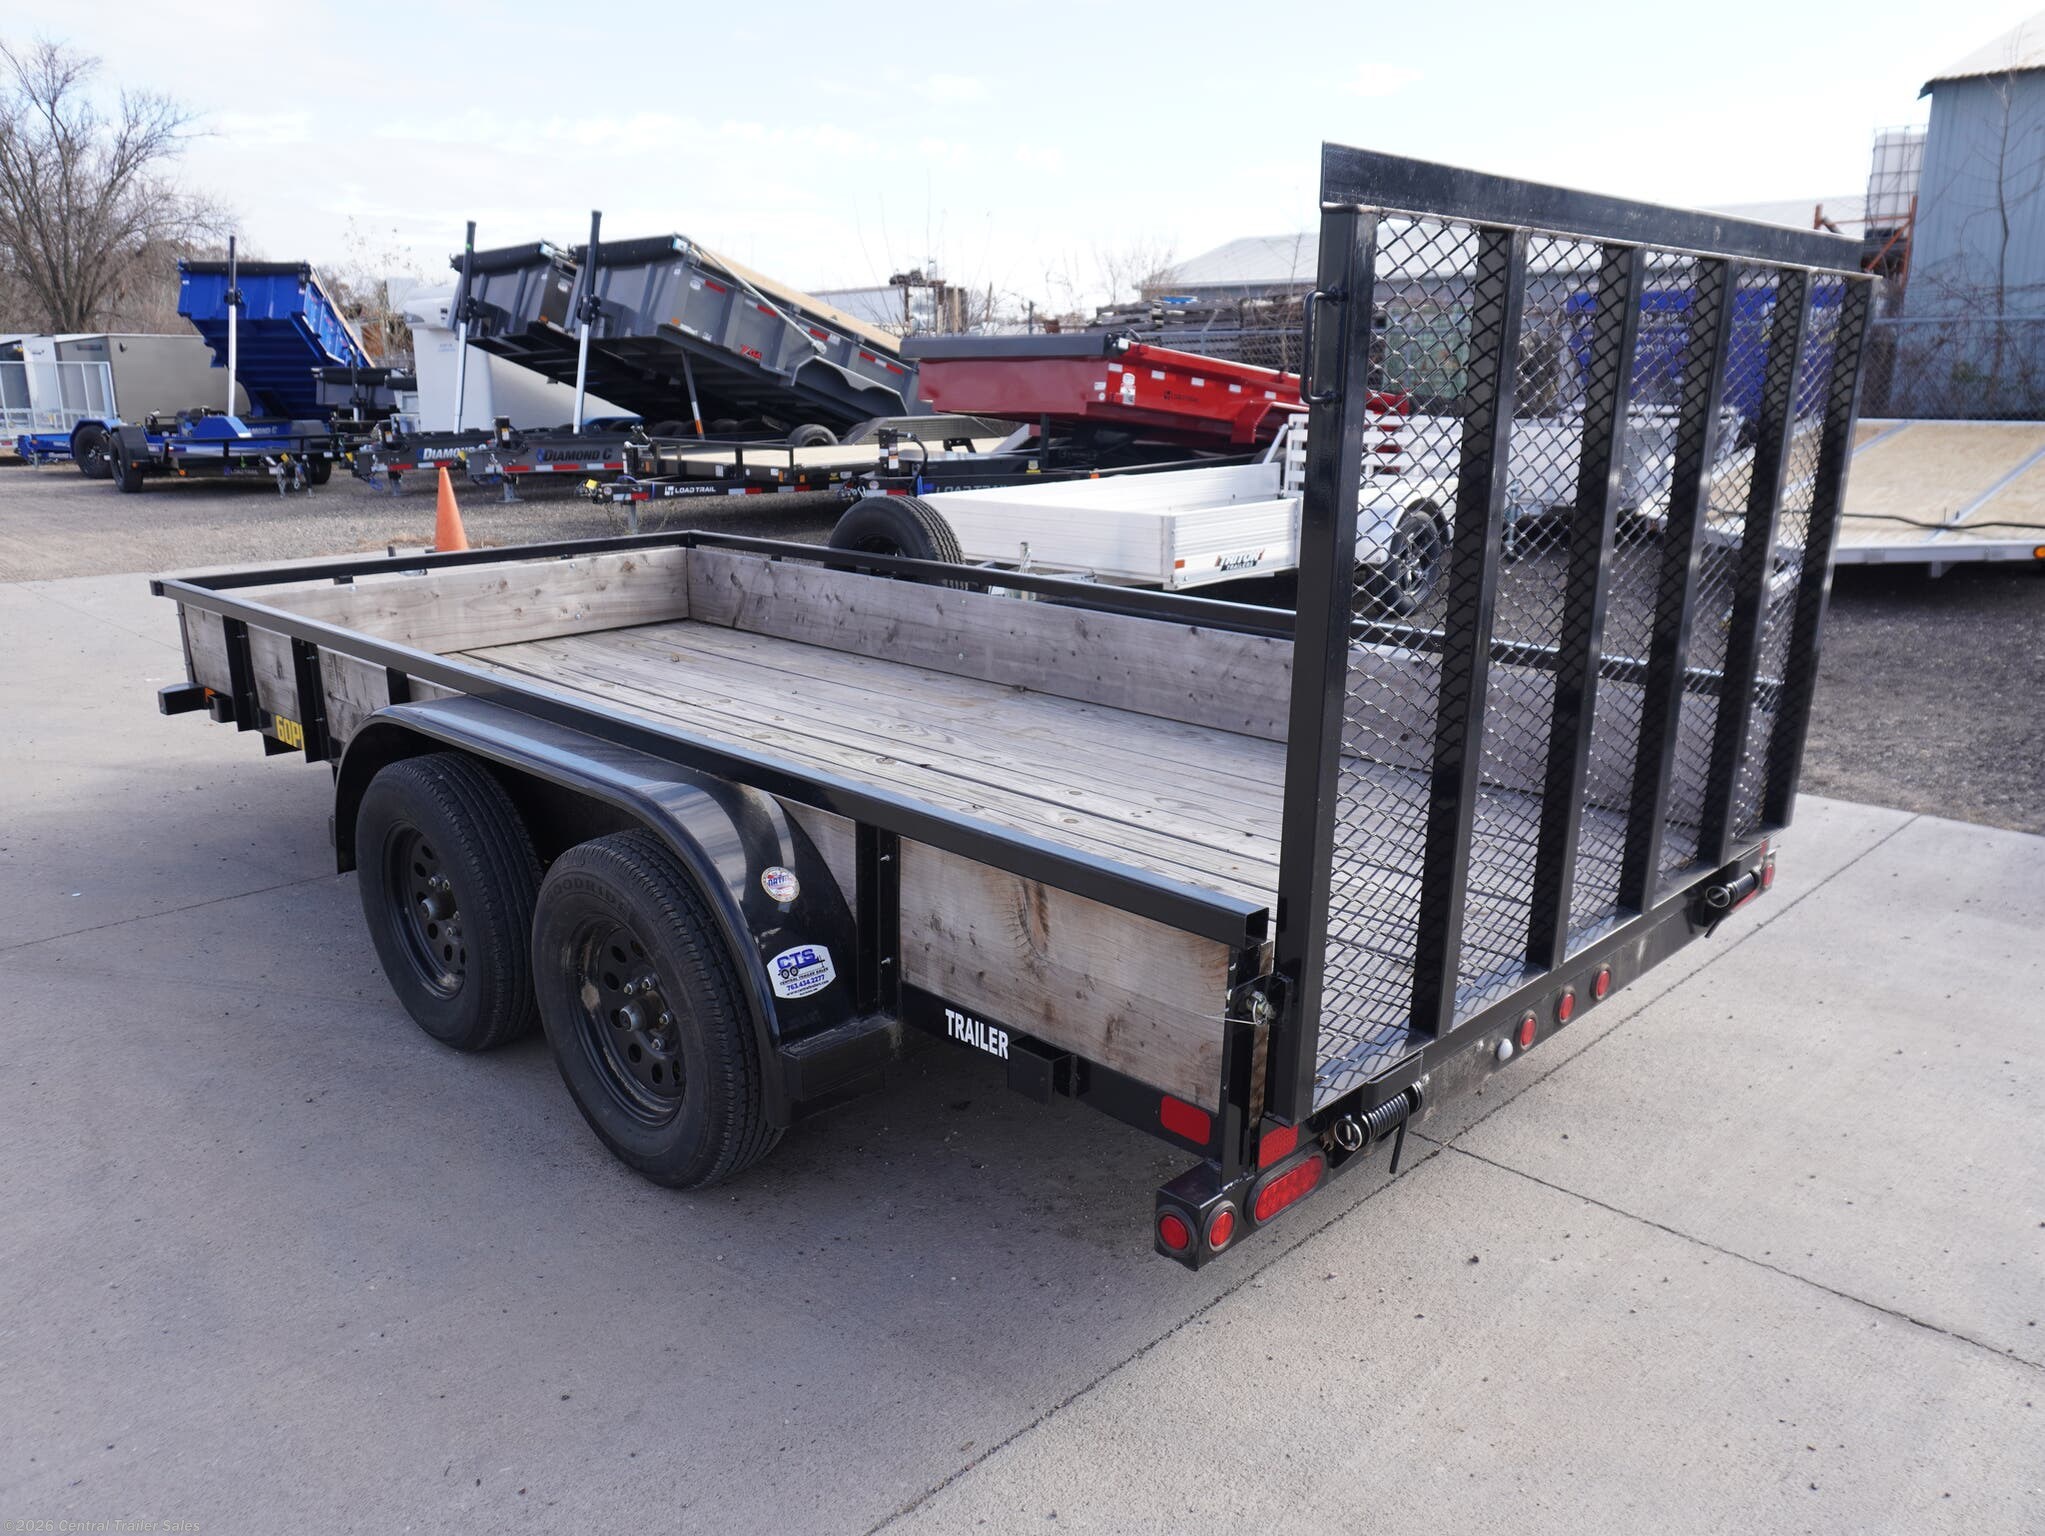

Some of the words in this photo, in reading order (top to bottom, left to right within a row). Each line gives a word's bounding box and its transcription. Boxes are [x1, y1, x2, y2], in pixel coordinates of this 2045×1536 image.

[543, 450, 600, 462] DIAMOND
[603, 448, 613, 460] C
[675, 486, 695, 494] LOAD
[777, 948, 816, 969] CTS
[945, 1008, 1009, 1060] TRAILER
